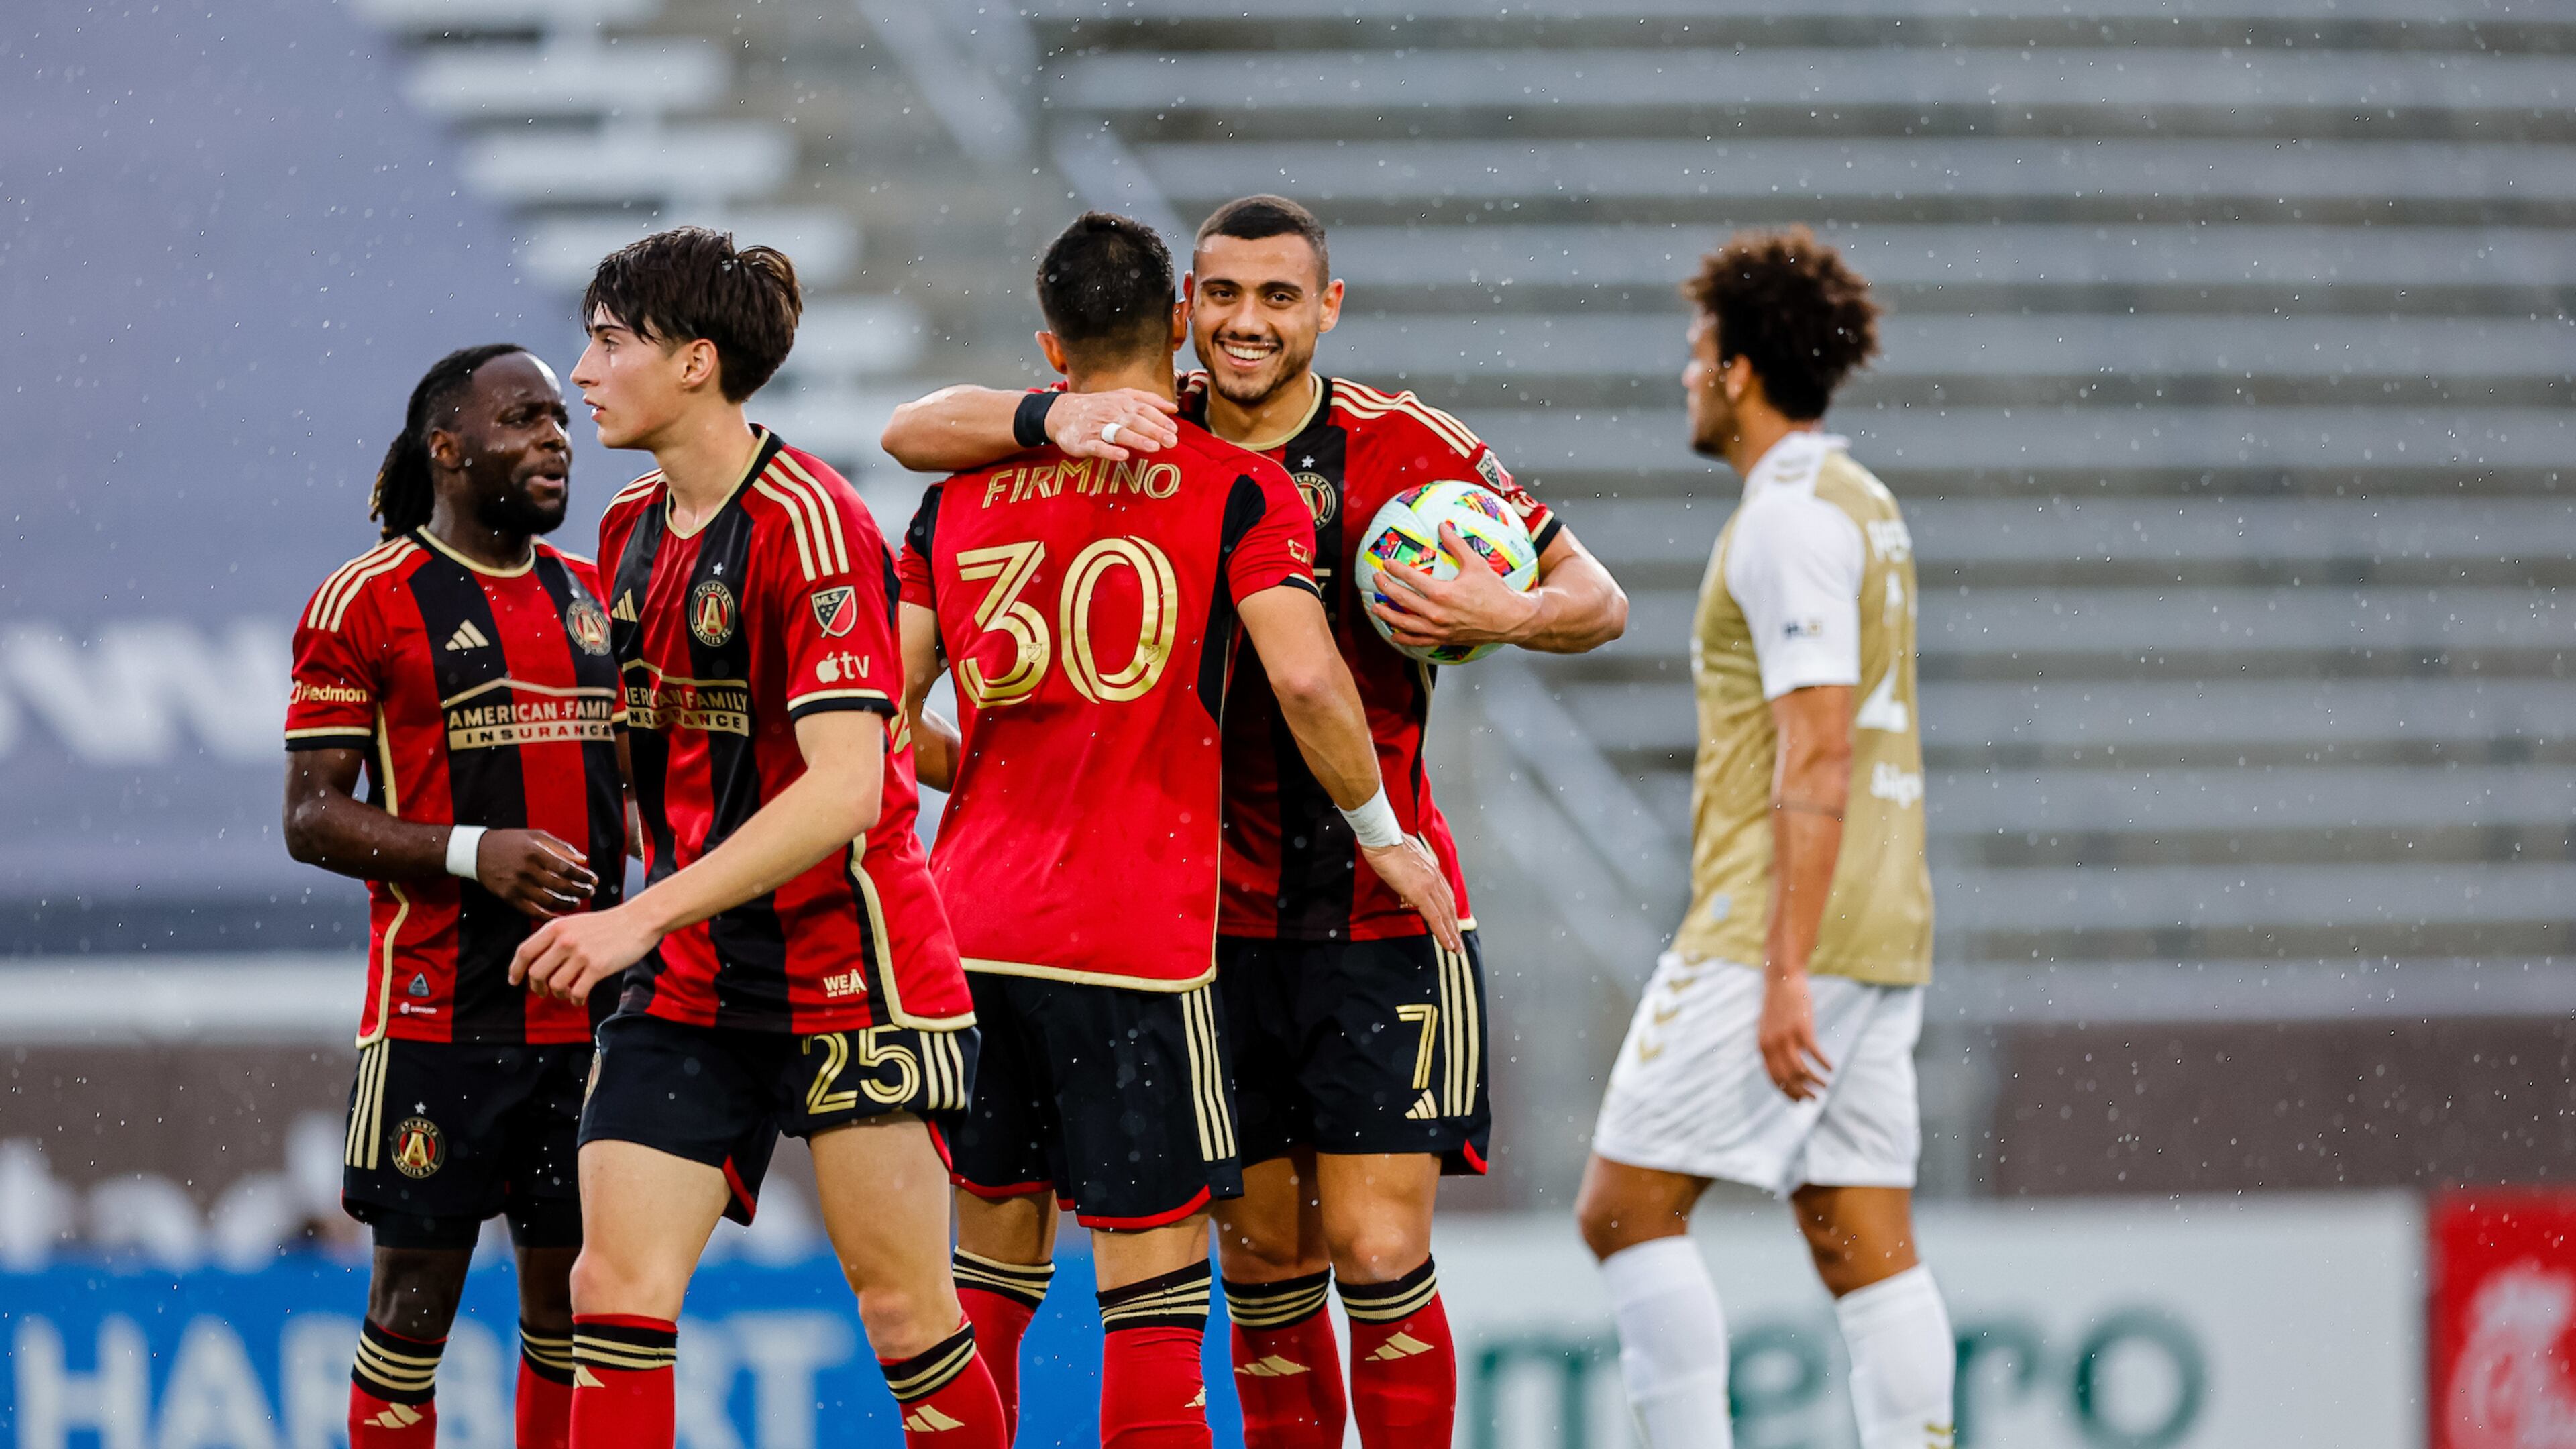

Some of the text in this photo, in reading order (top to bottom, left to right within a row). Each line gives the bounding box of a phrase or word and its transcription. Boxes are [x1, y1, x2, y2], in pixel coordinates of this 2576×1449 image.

[981, 458, 1182, 510] FIRMINO
[1294, 475, 1327, 491] LANTA
[815, 592, 841, 607] MLS
[956, 535, 1179, 710] 30
[839, 651, 870, 680] tv
[300, 683, 369, 703] Piedmon
[625, 686, 747, 712] ERICAN FAMILY
[449, 701, 558, 729] AMERICAN
[629, 710, 741, 729] NSURANCE
[466, 723, 611, 743] INSURANCE
[1395, 1004, 1438, 1089] 7
[802, 1024, 920, 1115] 25
